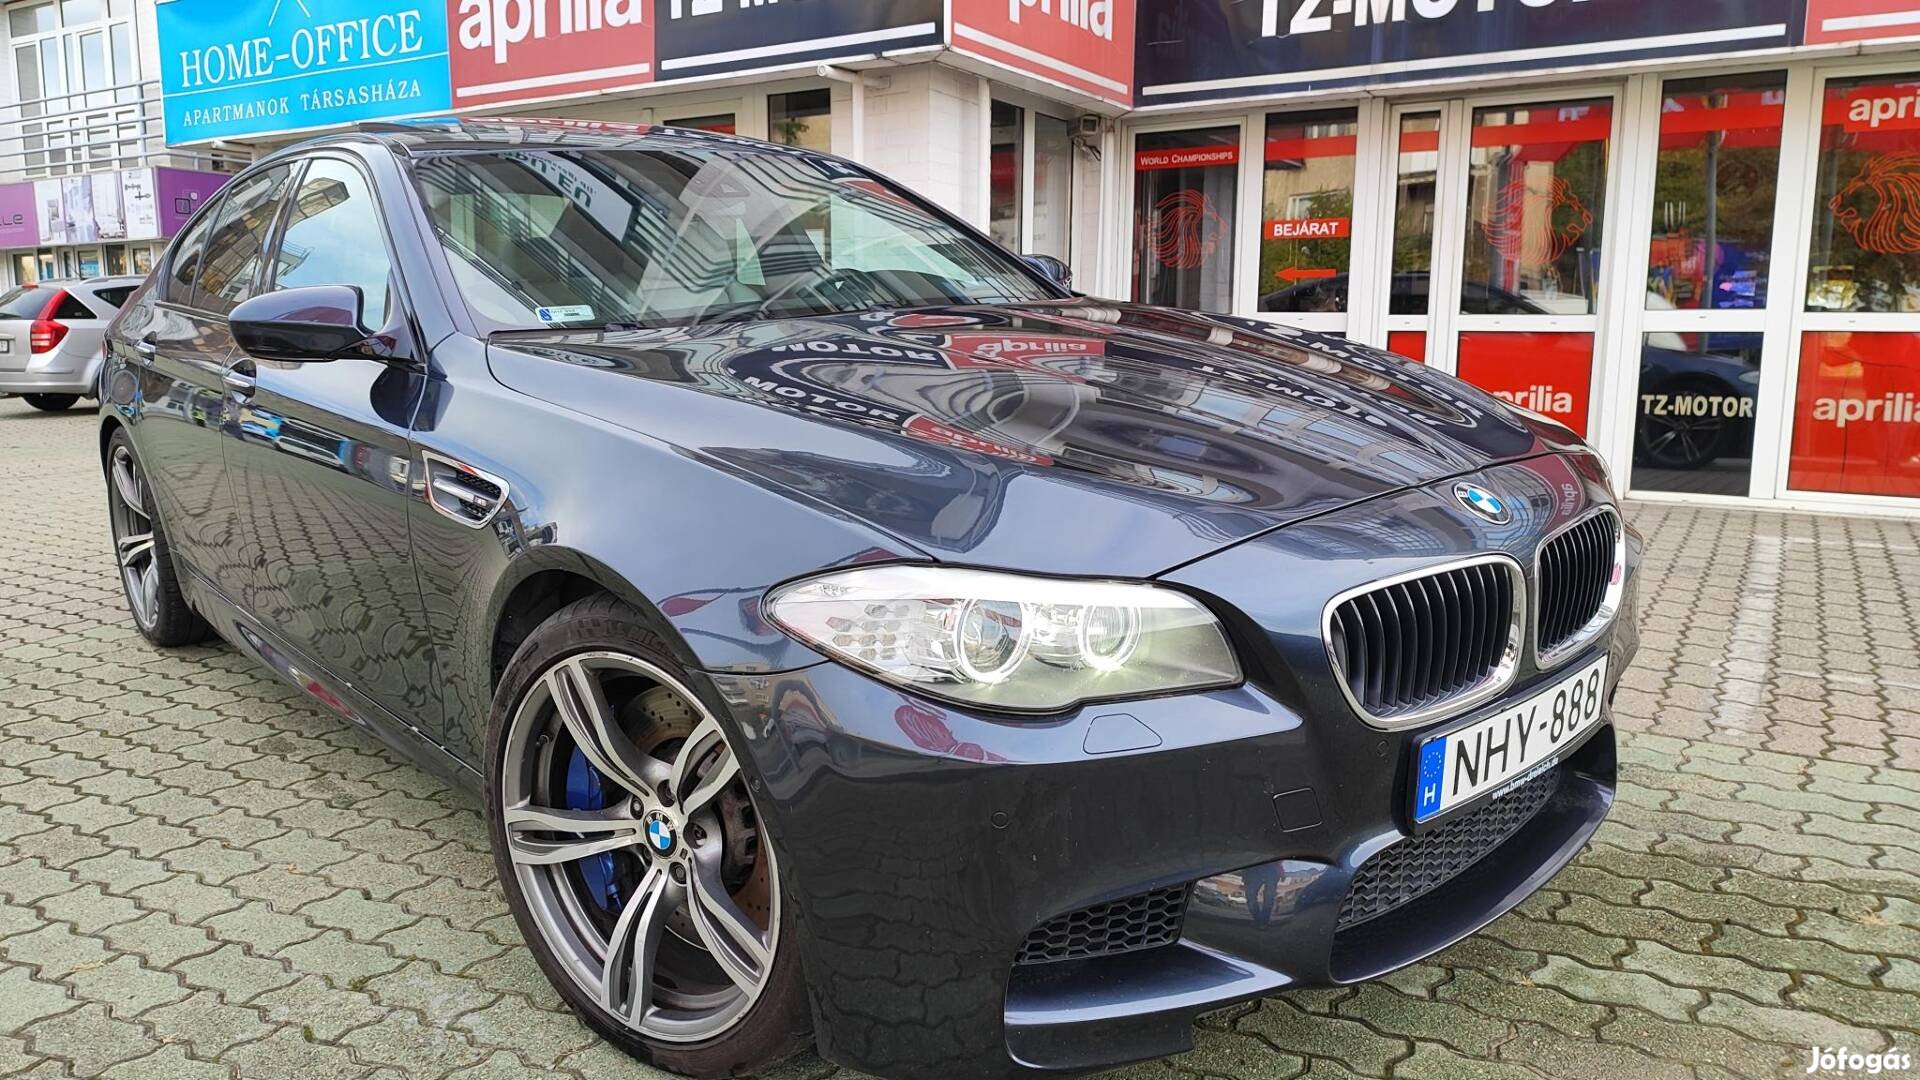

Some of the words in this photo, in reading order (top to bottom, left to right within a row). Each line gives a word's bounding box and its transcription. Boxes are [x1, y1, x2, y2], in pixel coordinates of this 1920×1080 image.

[179, 9, 423, 88] HOME-OFFICE
[183, 97, 290, 127] APARTMANOK
[300, 79, 422, 112] TÁRSASHÁZA
[1140, 155, 1169, 166] WORLD
[1171, 151, 1233, 163] CHAMPIONSHIPS
[1273, 220, 1339, 237] BEJÁRAT
[1641, 394, 1753, 418] TZ-MOTOR
[1452, 668, 1600, 796] NHY-888
[1423, 783, 1436, 807] H
